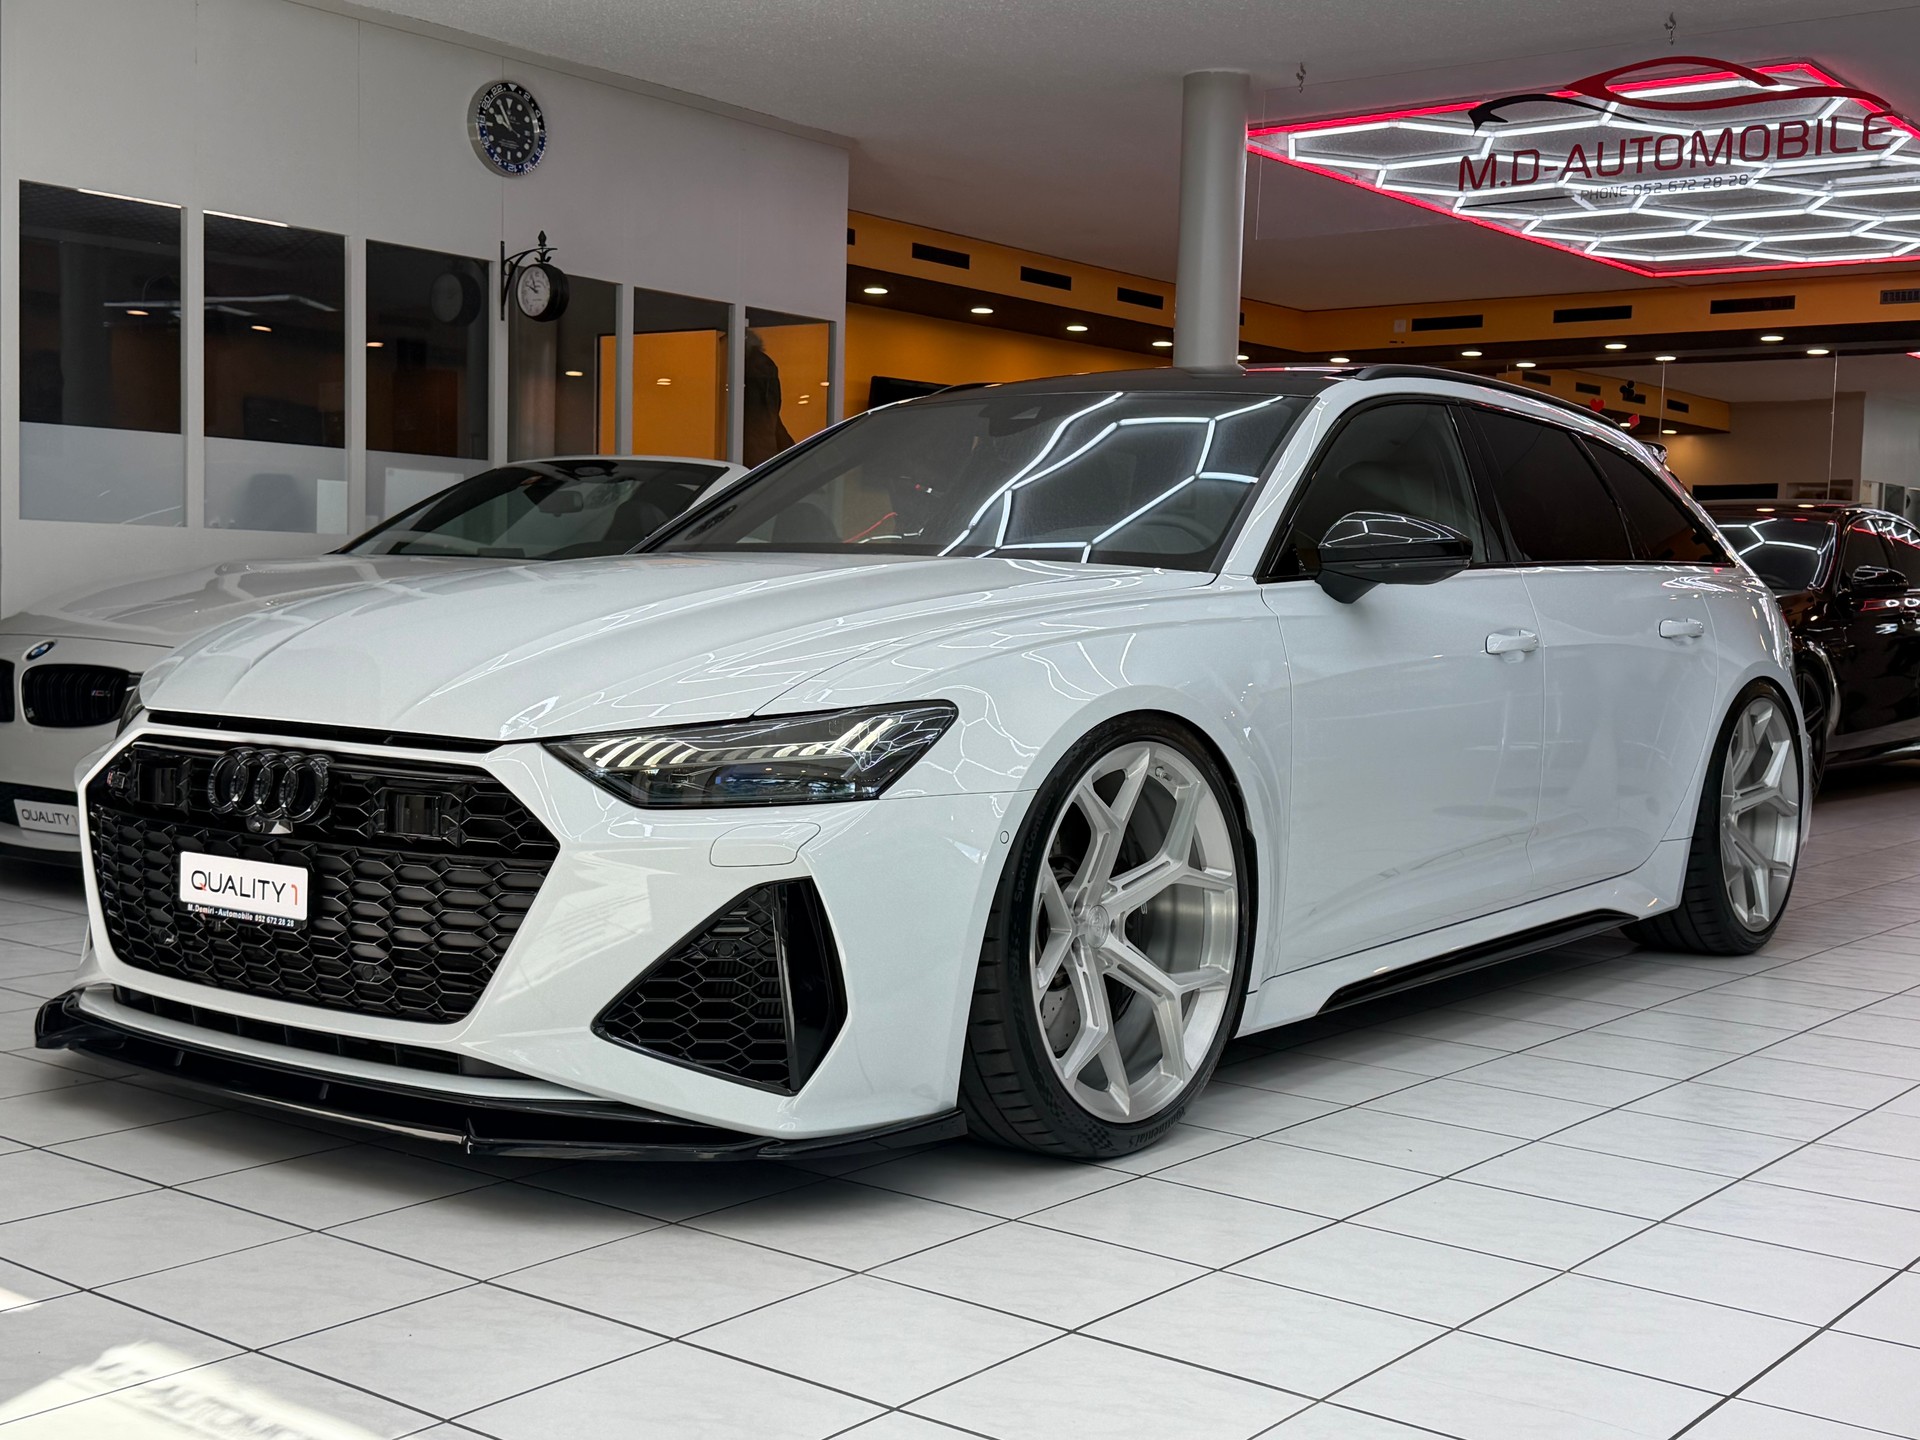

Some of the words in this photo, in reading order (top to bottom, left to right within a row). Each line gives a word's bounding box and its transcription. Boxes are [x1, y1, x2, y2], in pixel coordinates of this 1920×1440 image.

[491, 84, 503, 96] 22
[523, 91, 531, 102] 2
[1459, 110, 1893, 191] M.D-AUTOMOBILE
[1580, 185, 1628, 200] PHONE
[1633, 182, 1662, 196] 052
[1668, 179, 1697, 192] 672
[1702, 176, 1723, 189] 28
[1728, 174, 1749, 187] 28
[21, 809, 70, 825] QUALITY
[191, 870, 286, 903] QUALITY
[291, 884, 298, 905] 1
[266, 916, 277, 925] 672
[278, 918, 286, 926] 28
[287, 919, 295, 928] 28
